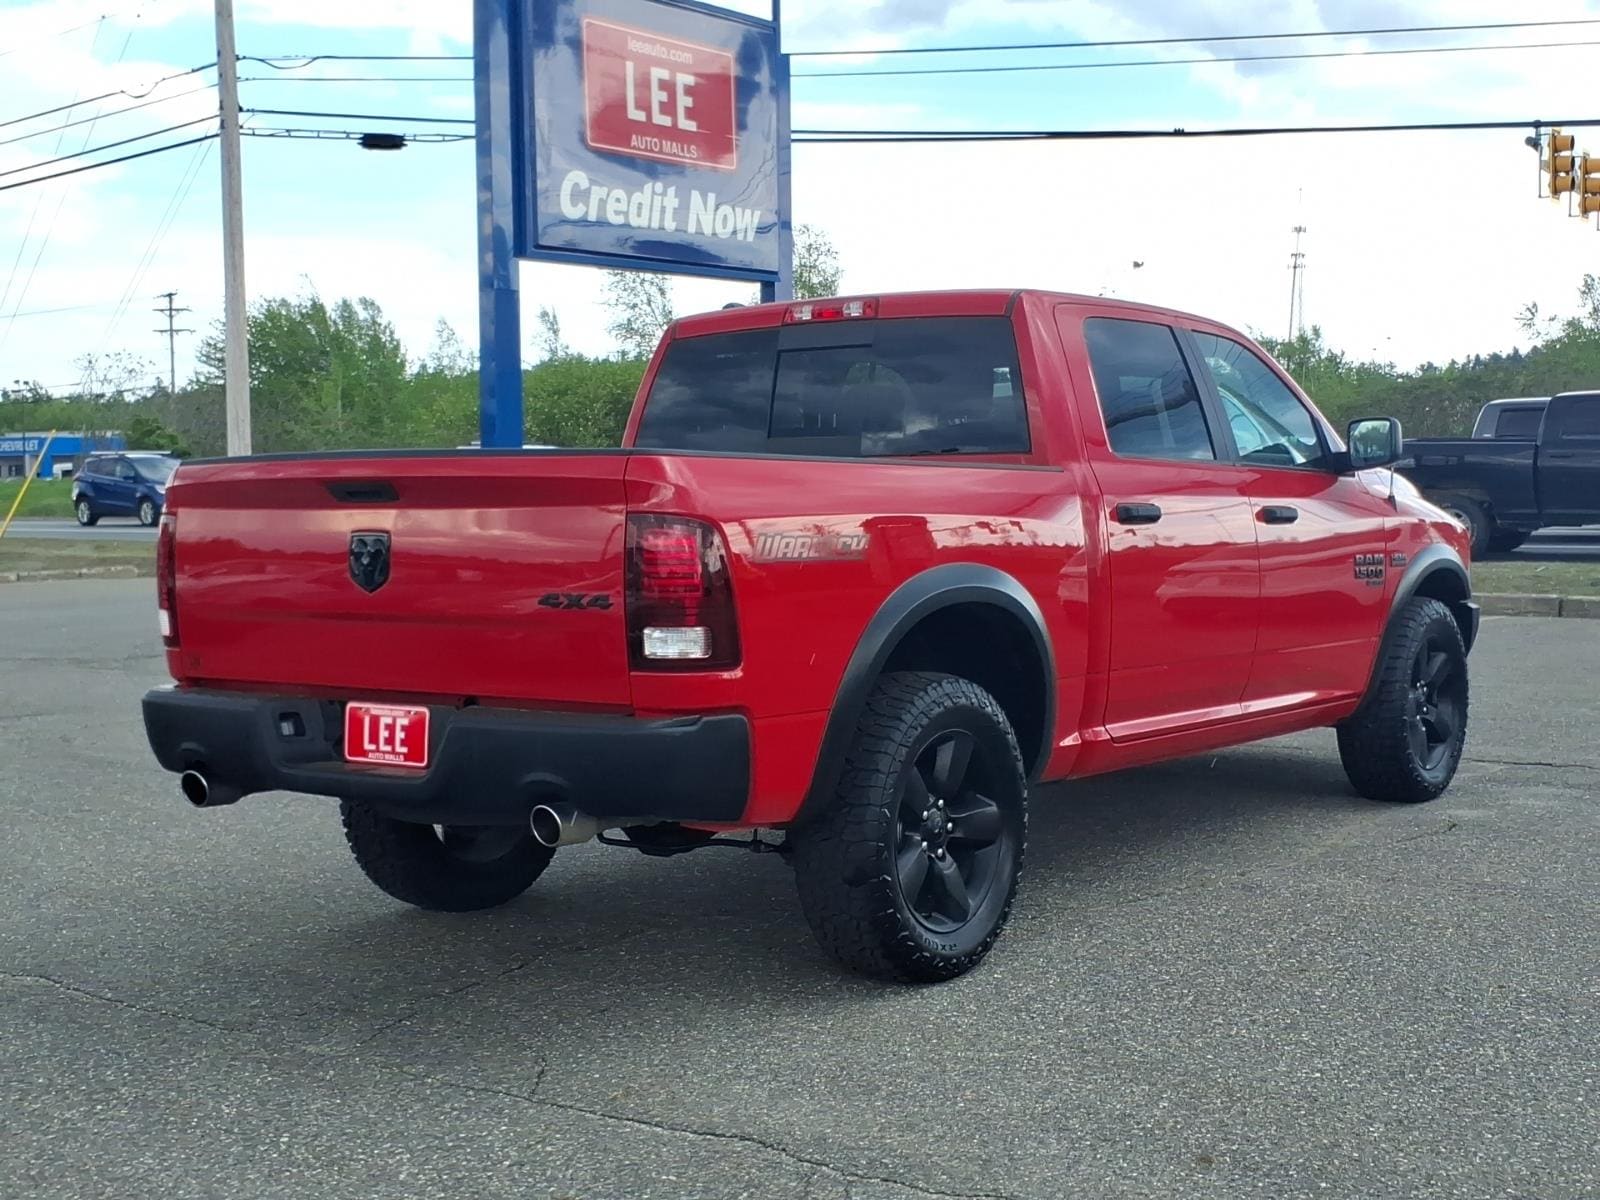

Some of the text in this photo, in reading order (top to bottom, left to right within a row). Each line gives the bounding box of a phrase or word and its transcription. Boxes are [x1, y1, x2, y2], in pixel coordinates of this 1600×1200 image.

[627, 36, 693, 64] leeauto.com
[625, 61, 697, 131] LEE
[630, 134, 698, 158] AUTO MALLS
[560, 170, 761, 242] Credit Now
[1354, 553, 1385, 566] RAM
[1354, 566, 1384, 579] 1500
[363, 714, 410, 753] LEE
[368, 752, 405, 762] AUTO MALLS
